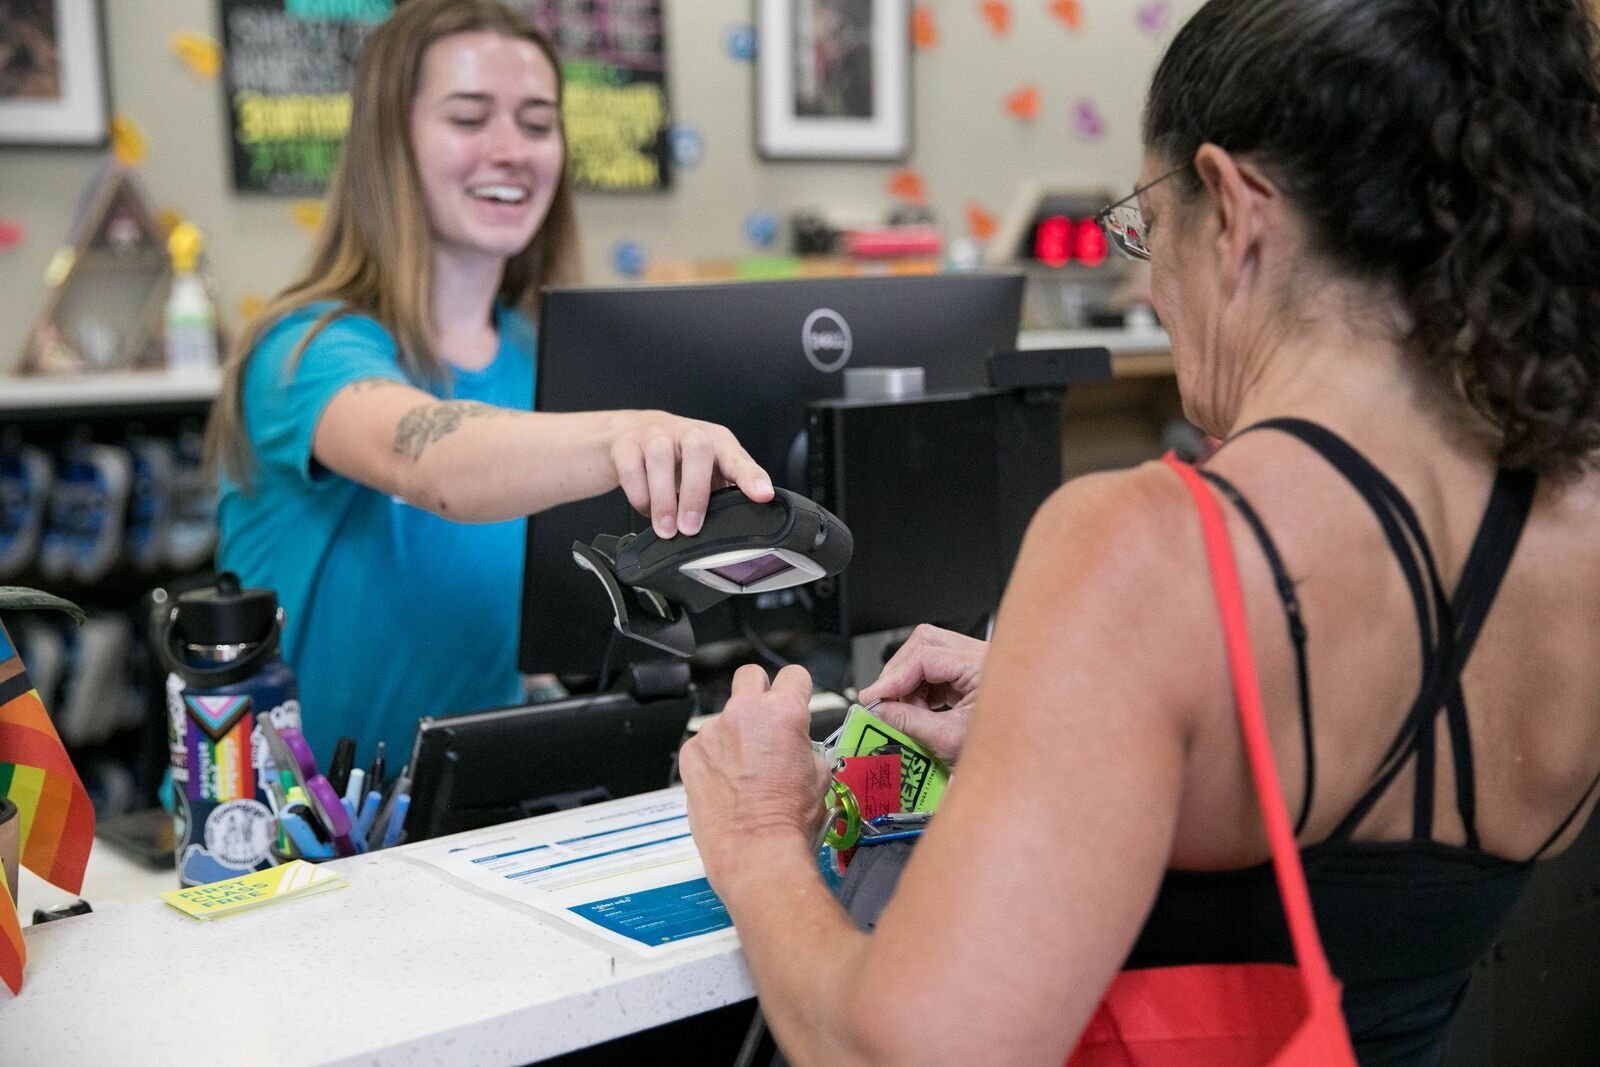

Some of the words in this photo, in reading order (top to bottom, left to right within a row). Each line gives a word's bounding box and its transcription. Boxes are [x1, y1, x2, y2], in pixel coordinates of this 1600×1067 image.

[178, 880, 245, 899] FIRST
[191, 883, 269, 903] CLASS
[201, 890, 266, 908] FREE
